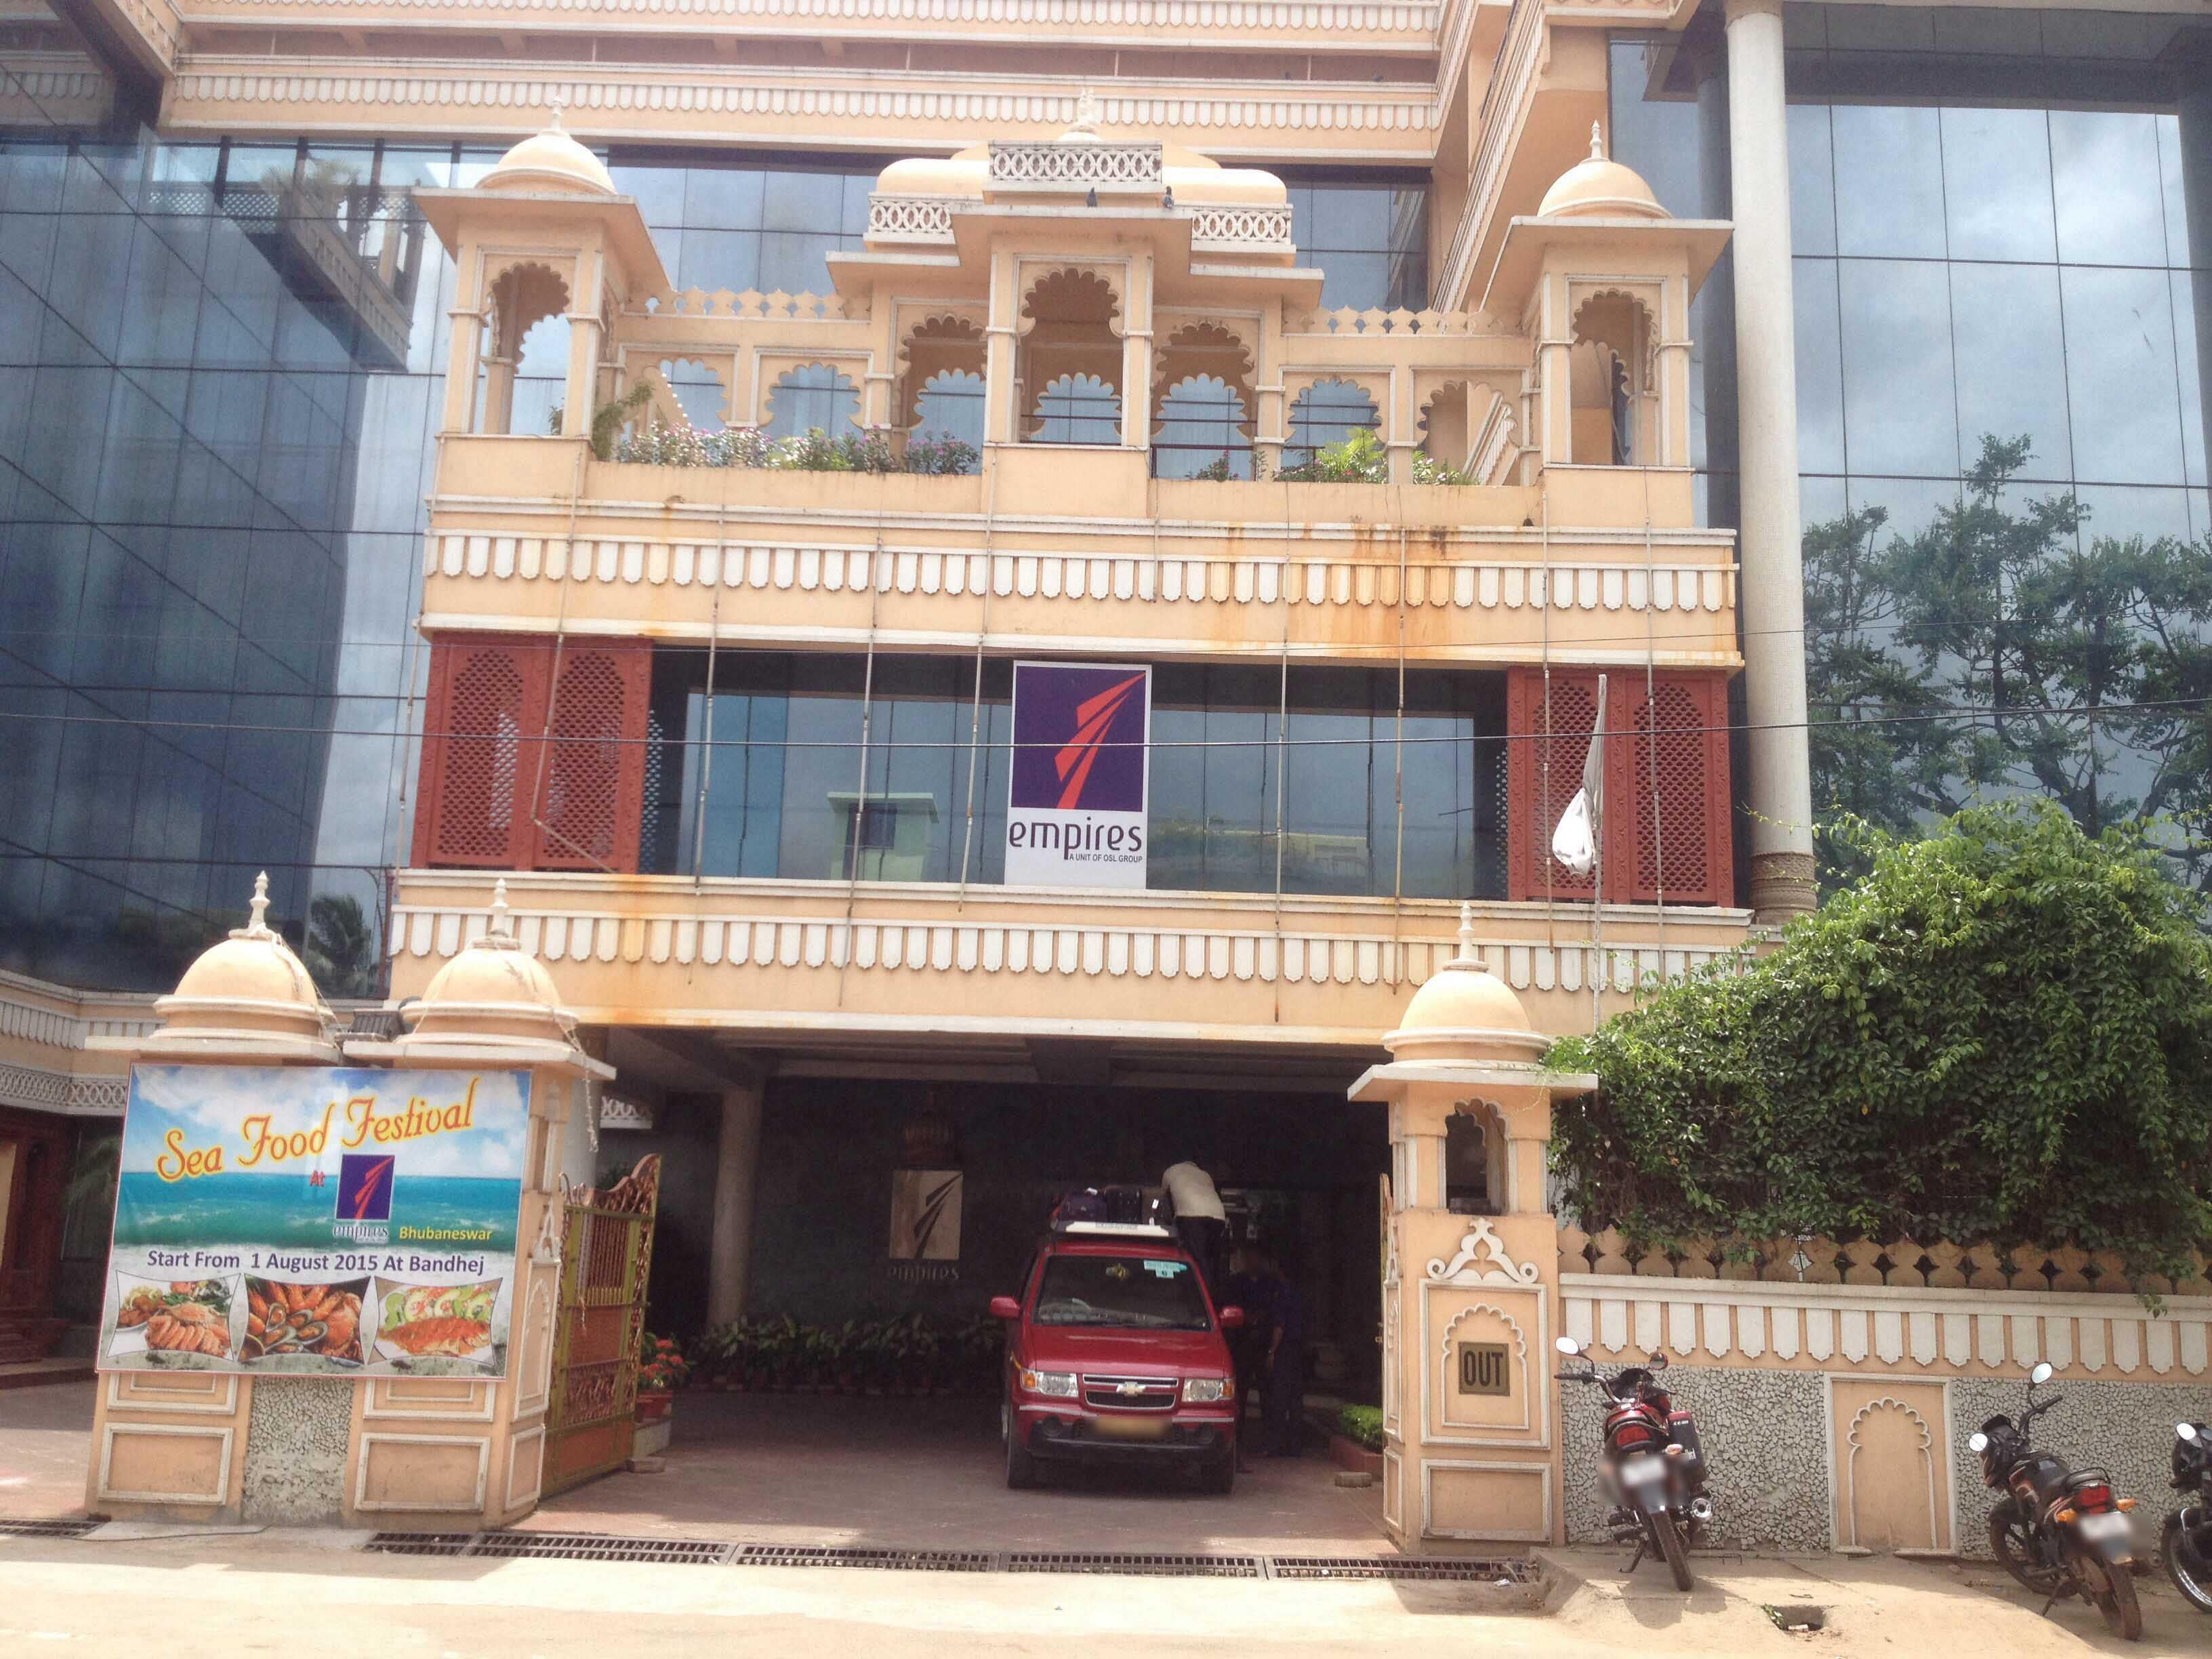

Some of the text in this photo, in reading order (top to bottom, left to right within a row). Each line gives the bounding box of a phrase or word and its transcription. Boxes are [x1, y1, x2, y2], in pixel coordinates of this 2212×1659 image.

[1009, 817, 1142, 860] empires
[156, 1077, 479, 1181] Sea Food Festival
[310, 1170, 325, 1186] At
[399, 1226, 493, 1241] Bhubaneswar
[147, 1250, 485, 1276] Start From 1 August 2015 At Bandhej
[1464, 1350, 1503, 1387] OUT
